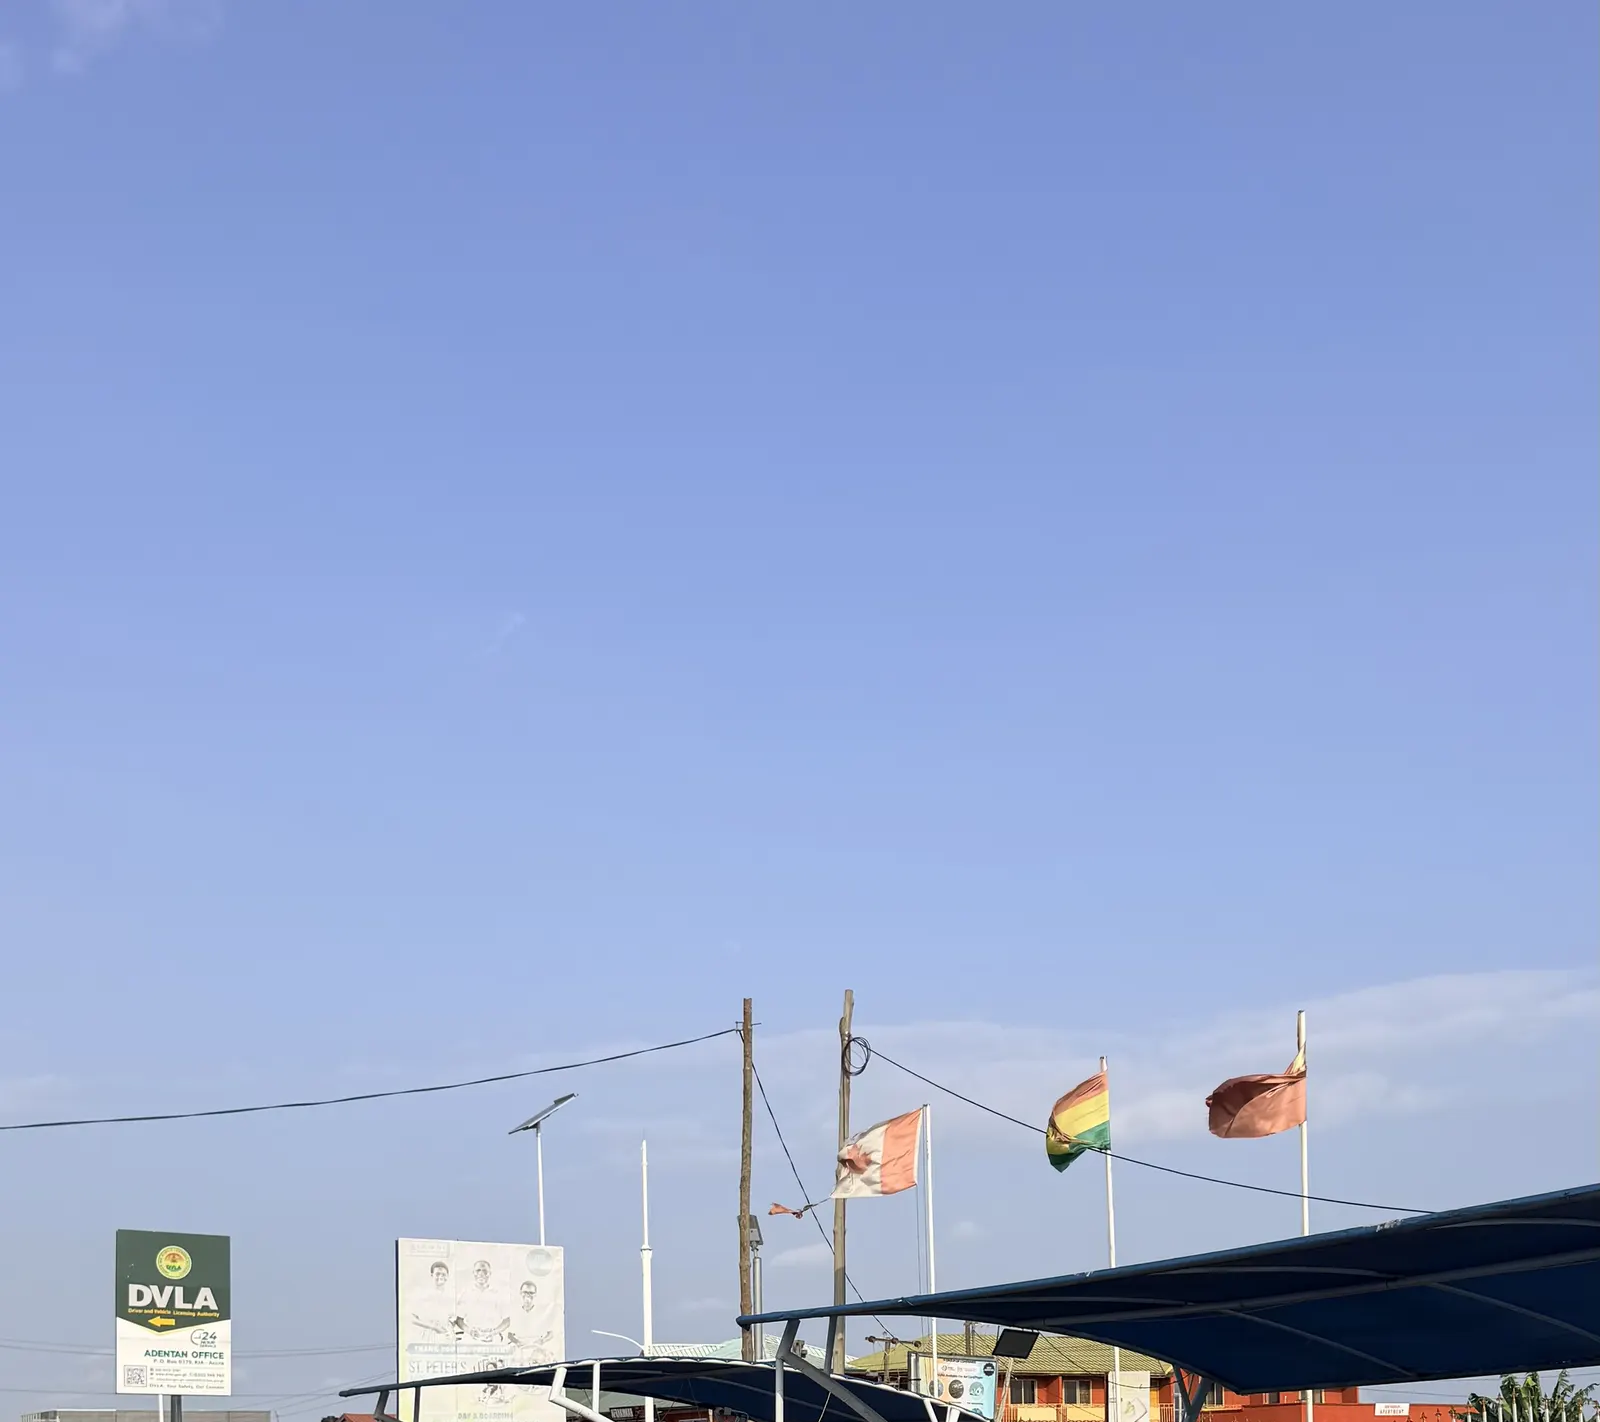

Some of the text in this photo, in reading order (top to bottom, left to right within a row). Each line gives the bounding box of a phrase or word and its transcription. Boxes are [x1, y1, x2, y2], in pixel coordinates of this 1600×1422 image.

[128, 1283, 219, 1310] DVLA
[196, 1311, 220, 1319] Authority
[201, 1331, 217, 1341] 24
[144, 1349, 224, 1360] ADENTAN OFFICE
